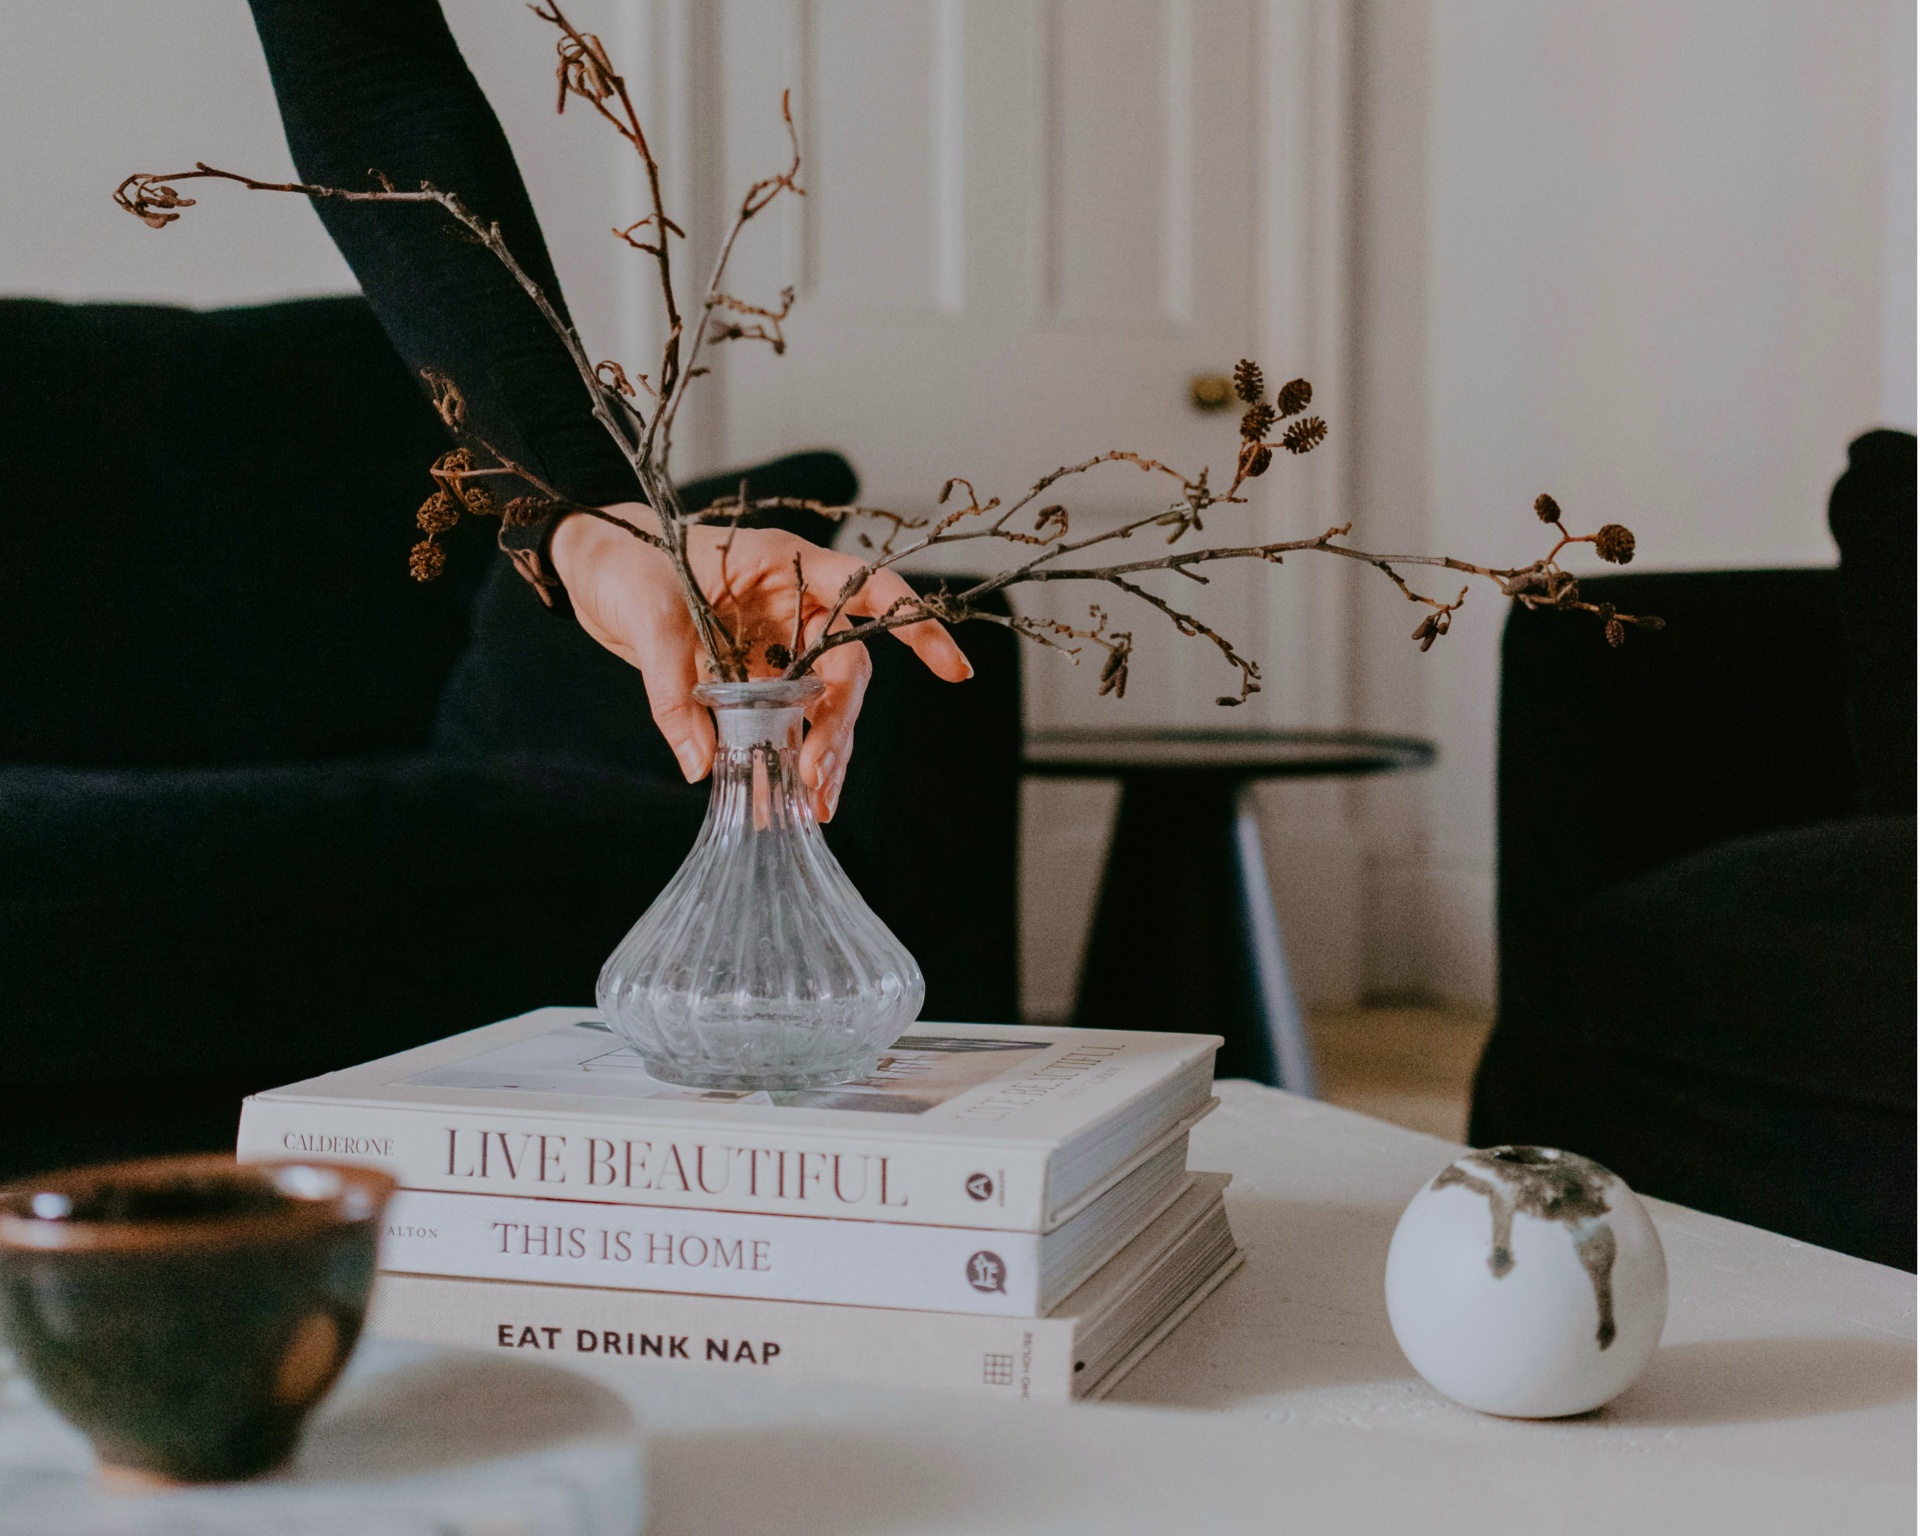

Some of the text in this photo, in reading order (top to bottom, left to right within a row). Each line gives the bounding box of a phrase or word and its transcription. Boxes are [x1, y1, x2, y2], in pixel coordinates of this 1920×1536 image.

[1001, 1044, 1126, 1097] BEAUTIFUL
[283, 1132, 394, 1156] CALDERONE
[443, 1127, 910, 1207] LIVE BEAUTIFUL
[386, 1225, 439, 1239] ALTON
[492, 1221, 772, 1272] THIS IS HOME
[497, 1323, 782, 1366] EAT DRINK NAP
